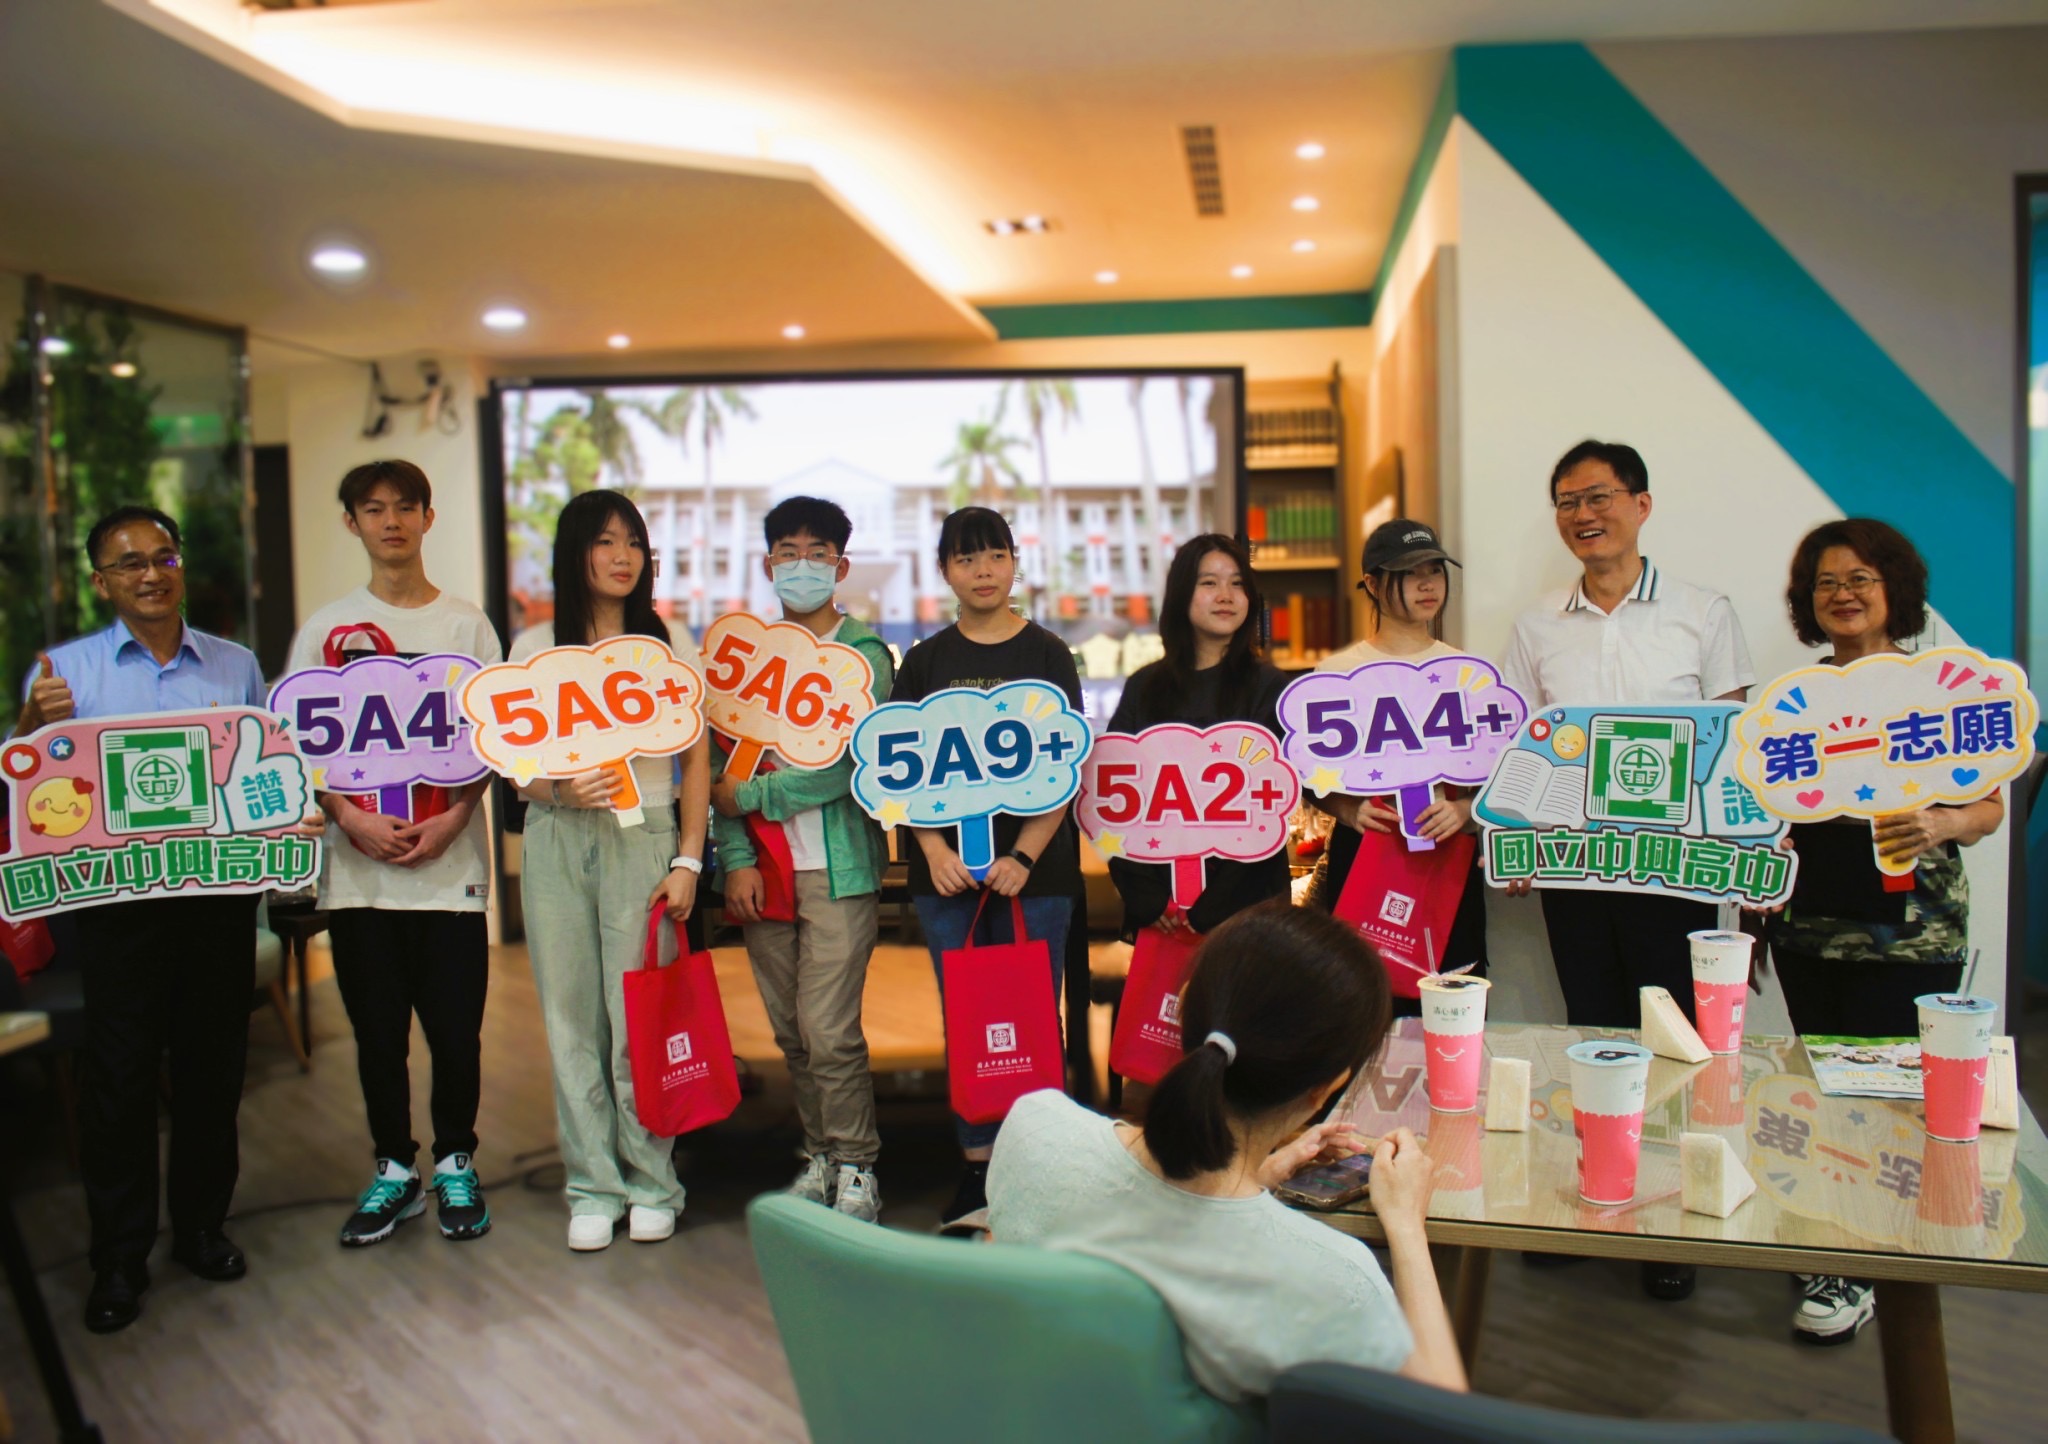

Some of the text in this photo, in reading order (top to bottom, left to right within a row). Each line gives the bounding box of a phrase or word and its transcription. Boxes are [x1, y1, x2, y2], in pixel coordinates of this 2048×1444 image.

[490, 671, 688, 747] 5A6+
[705, 634, 855, 731] 5A6+
[295, 691, 466, 756] 5A4
[878, 720, 1073, 792] 5A9+
[1306, 691, 1513, 756] 5A4+
[1758, 700, 2017, 785] 第一志願
[241, 769, 289, 820] 讚
[1096, 764, 1283, 825] 5A2+
[4, 838, 314, 909] 國立中興高中
[1495, 829, 1787, 899] 國立中興高中
